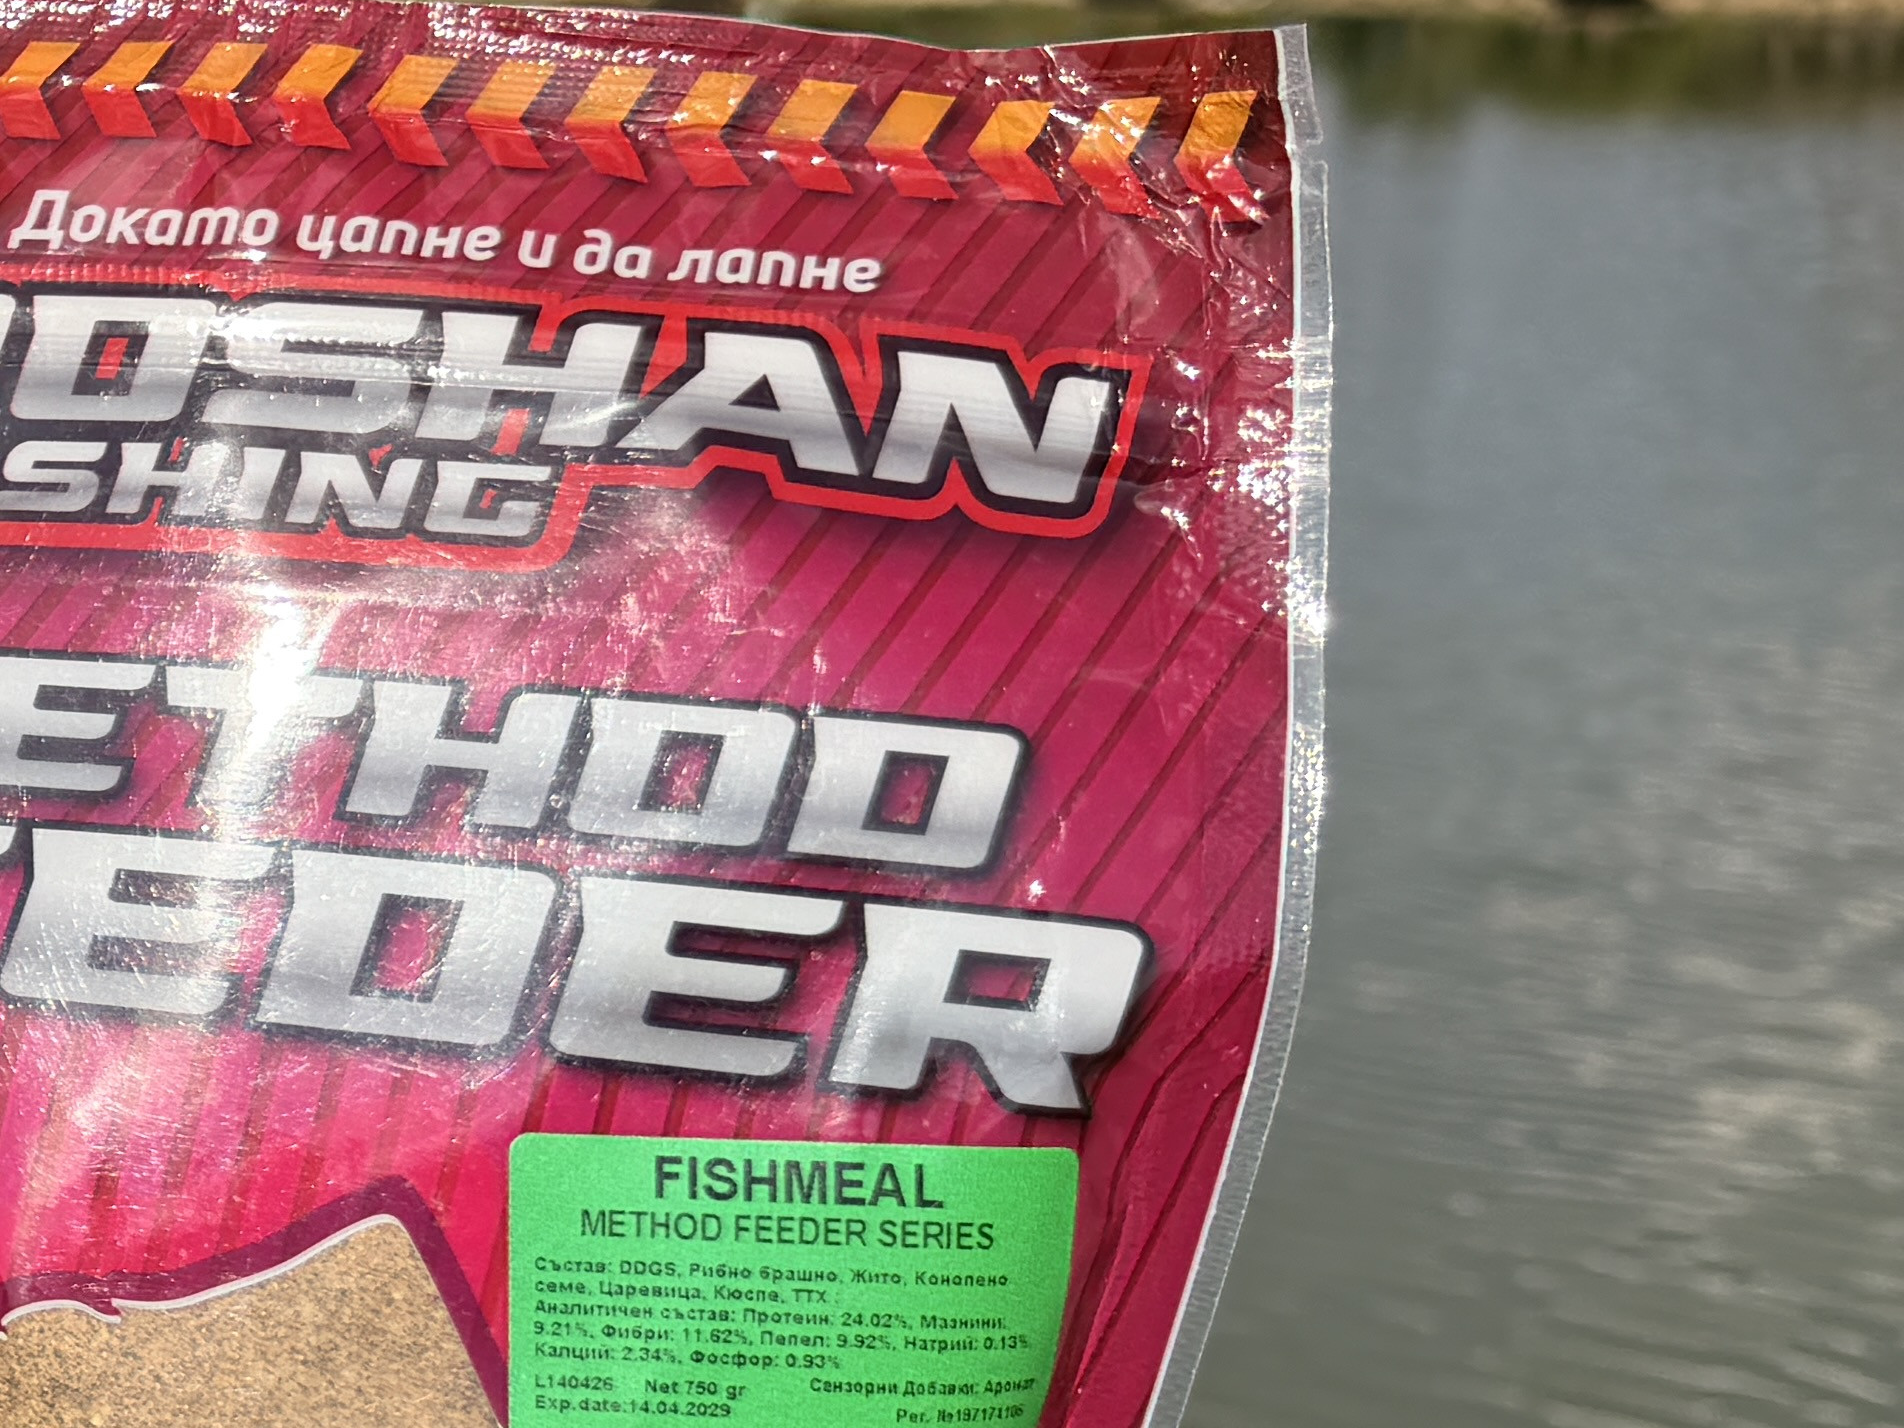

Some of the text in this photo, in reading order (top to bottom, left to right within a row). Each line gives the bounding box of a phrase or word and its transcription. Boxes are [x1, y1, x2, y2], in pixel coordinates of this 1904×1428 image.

[7, 189, 883, 294] Докато цапне и да лапне
[655, 1156, 944, 1210] FISHMEAL
[580, 1209, 995, 1251] METHOD FEEDER SERIES
[535, 1256, 613, 1274] Състав:
[620, 1259, 681, 1278] DDGS,
[689, 1262, 752, 1280] Рибно
[759, 1264, 843, 1285] брашно,
[850, 1269, 908, 1287] Жито,
[535, 1280, 592, 1297] семе,
[599, 1280, 709, 1301] Царевица,
[714, 1284, 786, 1305] Кюспе,
[535, 1299, 653, 1320] Аналитичен
[660, 1306, 736, 1323] състав:
[742, 1308, 835, 1328] Протеин:
[920, 1315, 1007, 1331] Мазнини:
[602, 1324, 674, 1342] Фибри:
[682, 1327, 754, 1347] 11.62%,
[760, 1330, 831, 1348] Пепел:
[904, 1335, 978, 1356] Натрий:
[534, 1342, 615, 1362] Калций:
[690, 1349, 779, 1371] Фосфор:
[645, 1378, 679, 1396] Net
[685, 1380, 718, 1397] 750
[725, 1383, 747, 1401] gr
[810, 1376, 898, 1399] Сензорни
